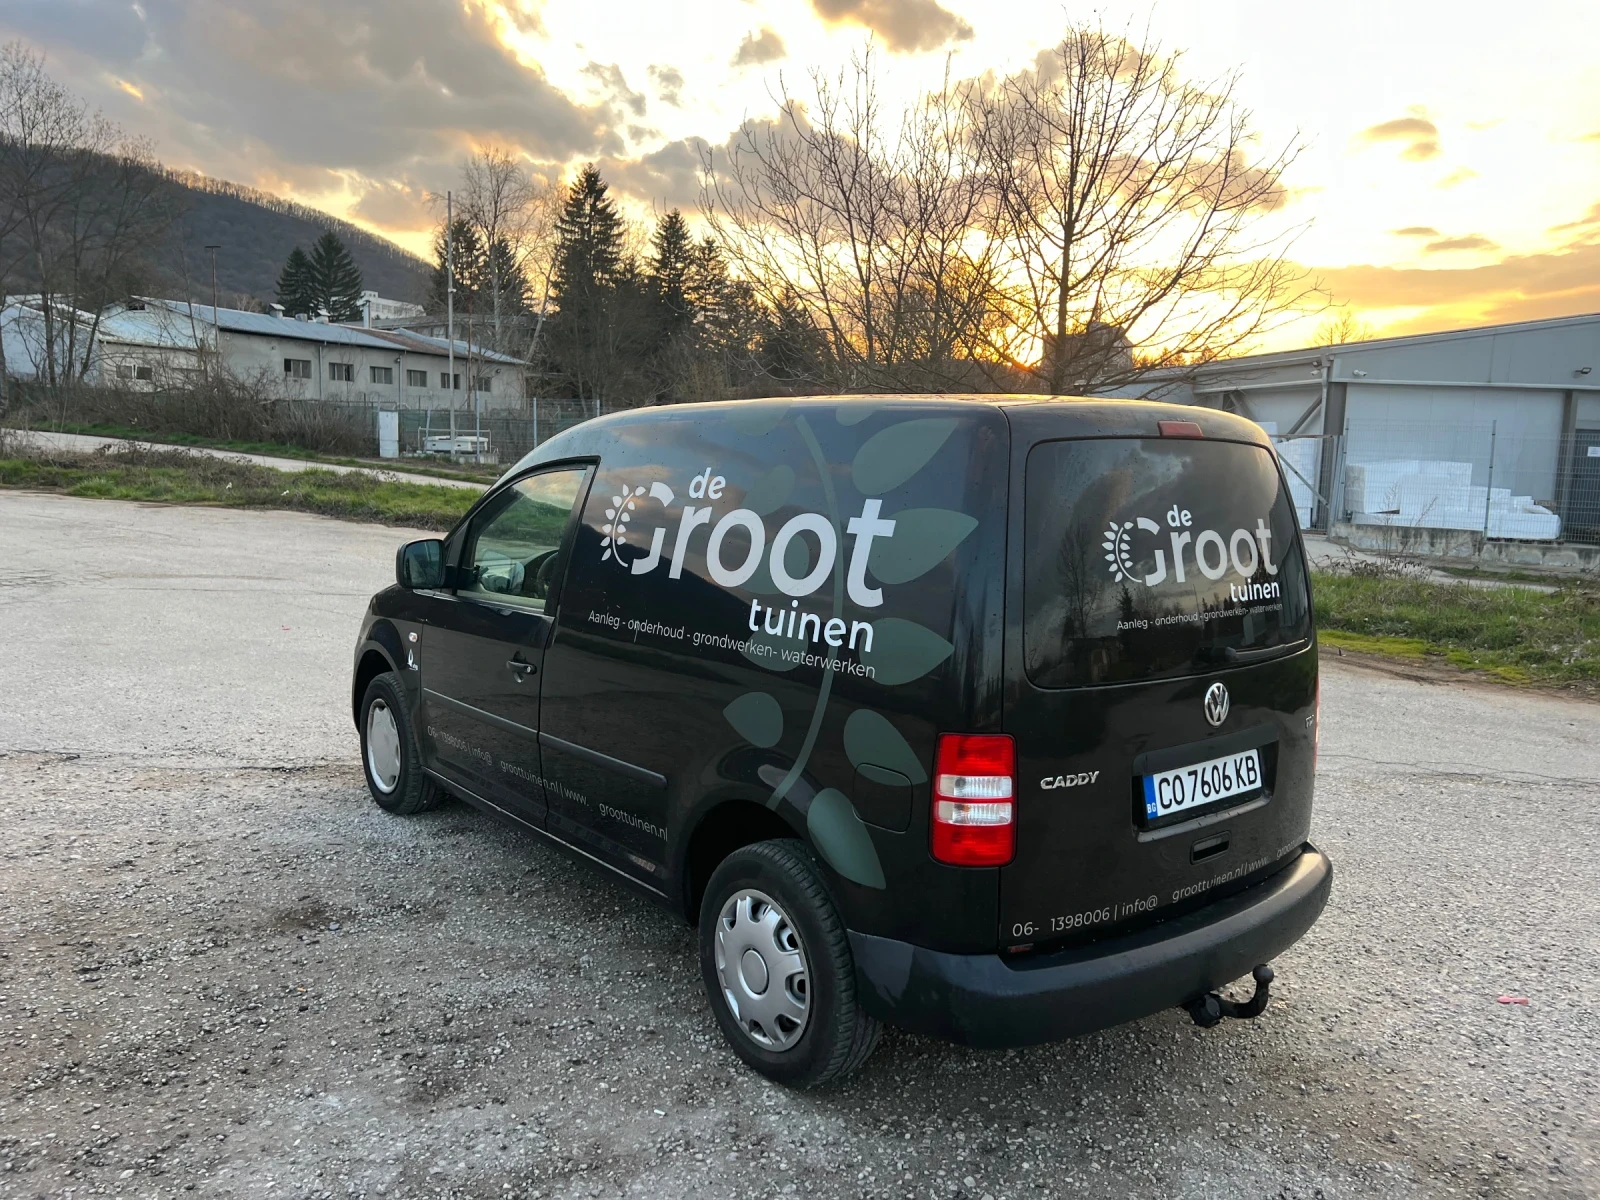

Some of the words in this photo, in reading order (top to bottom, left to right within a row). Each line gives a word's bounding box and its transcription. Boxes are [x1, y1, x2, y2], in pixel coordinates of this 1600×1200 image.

[689, 467, 726, 499] de
[1166, 504, 1193, 527] de
[600, 481, 896, 608] Groot
[1102, 516, 1279, 587] Groot
[1230, 576, 1280, 602] tuinen
[748, 599, 875, 653] tuinen
[1117, 618, 1149, 631] Aanleg
[1155, 611, 1198, 626] onderhoud
[588, 610, 621, 630] Aanleg
[627, 619, 685, 641] onderhoud
[781, 648, 876, 679] waterwerken
[1040, 770, 1100, 790] CADDY
[1158, 774, 1186, 810] CO
[1187, 761, 1233, 802] 7606
[1233, 755, 1258, 789] KB
[599, 803, 668, 841] groottuinen.nl
[1146, 802, 1157, 813] BG
[1012, 922, 1040, 937] 06-
[1050, 907, 1110, 932] 1398006
[1121, 895, 1158, 916] info@
[1172, 863, 1244, 904] groottuinen.nl
